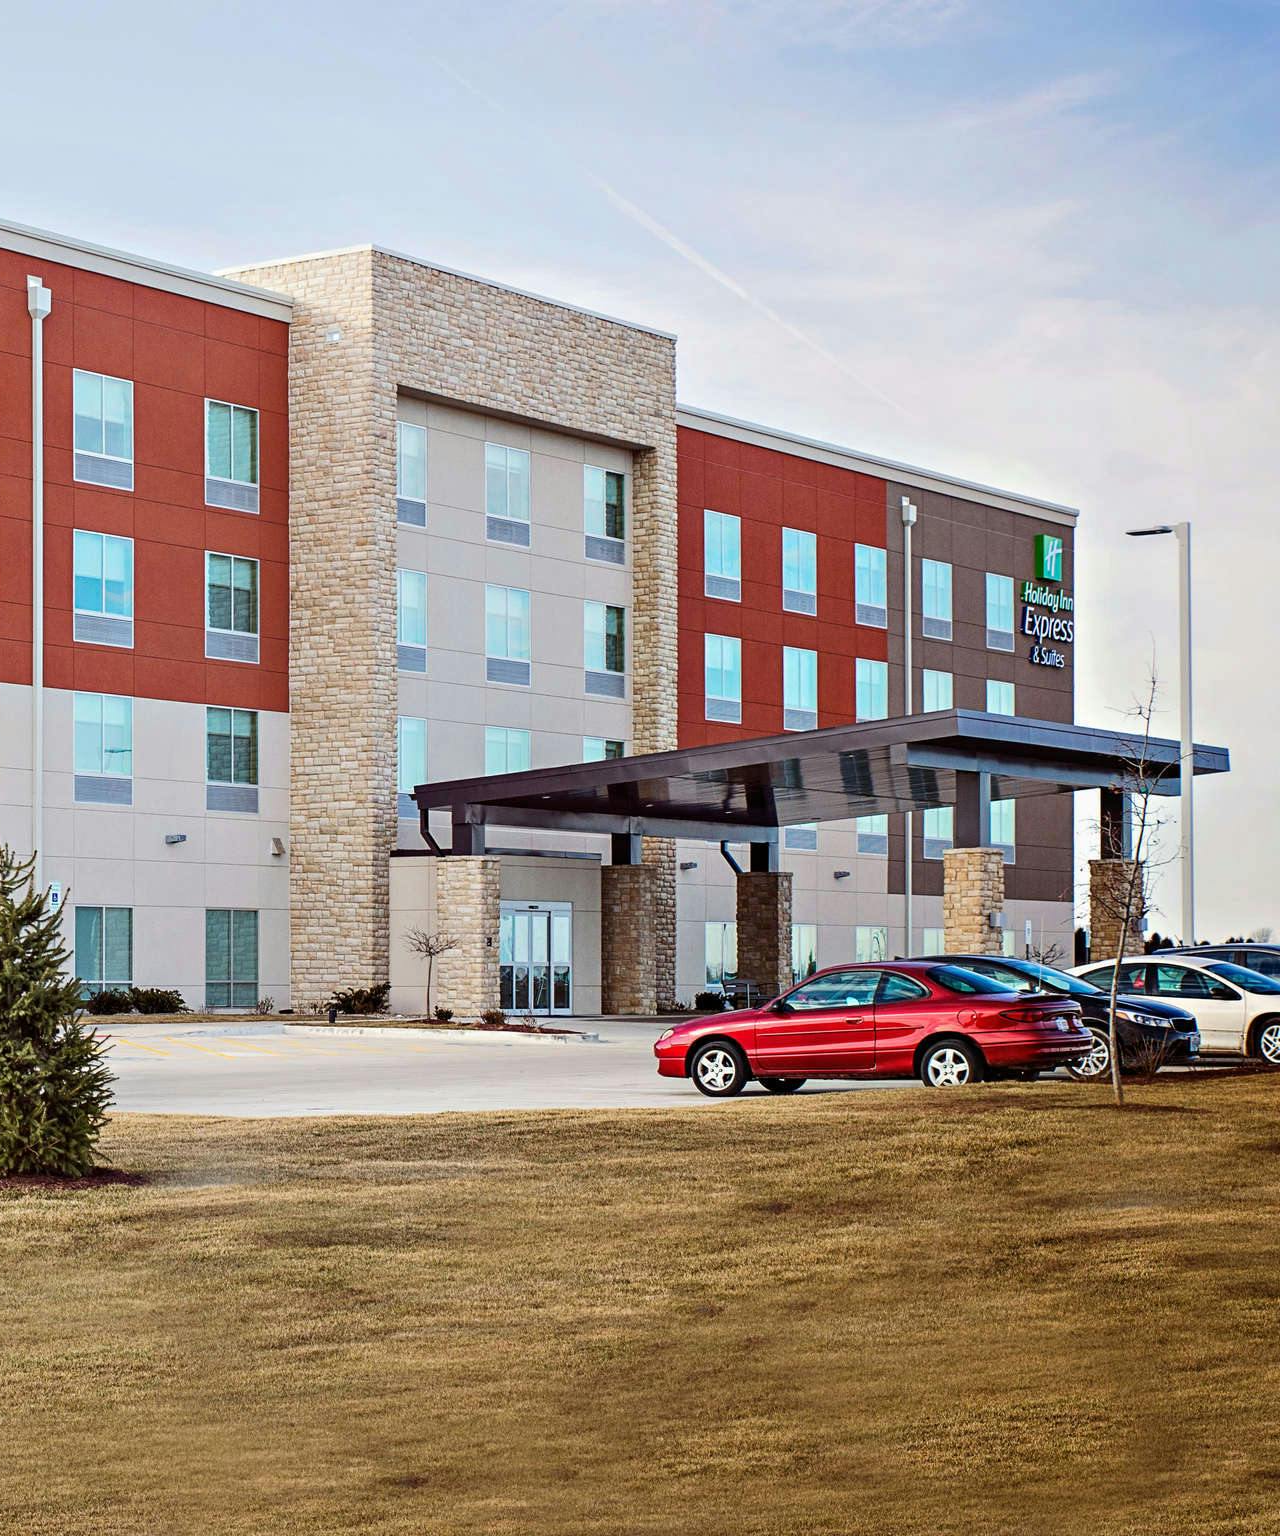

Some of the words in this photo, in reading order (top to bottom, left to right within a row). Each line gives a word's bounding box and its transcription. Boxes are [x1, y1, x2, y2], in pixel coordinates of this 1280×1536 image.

[1024, 582, 1060, 613] Holiday
[1060, 588, 1073, 611] Inn
[1024, 606, 1074, 644] Express
[1033, 646, 1040, 664] &
[1041, 647, 1065, 668] Suites
